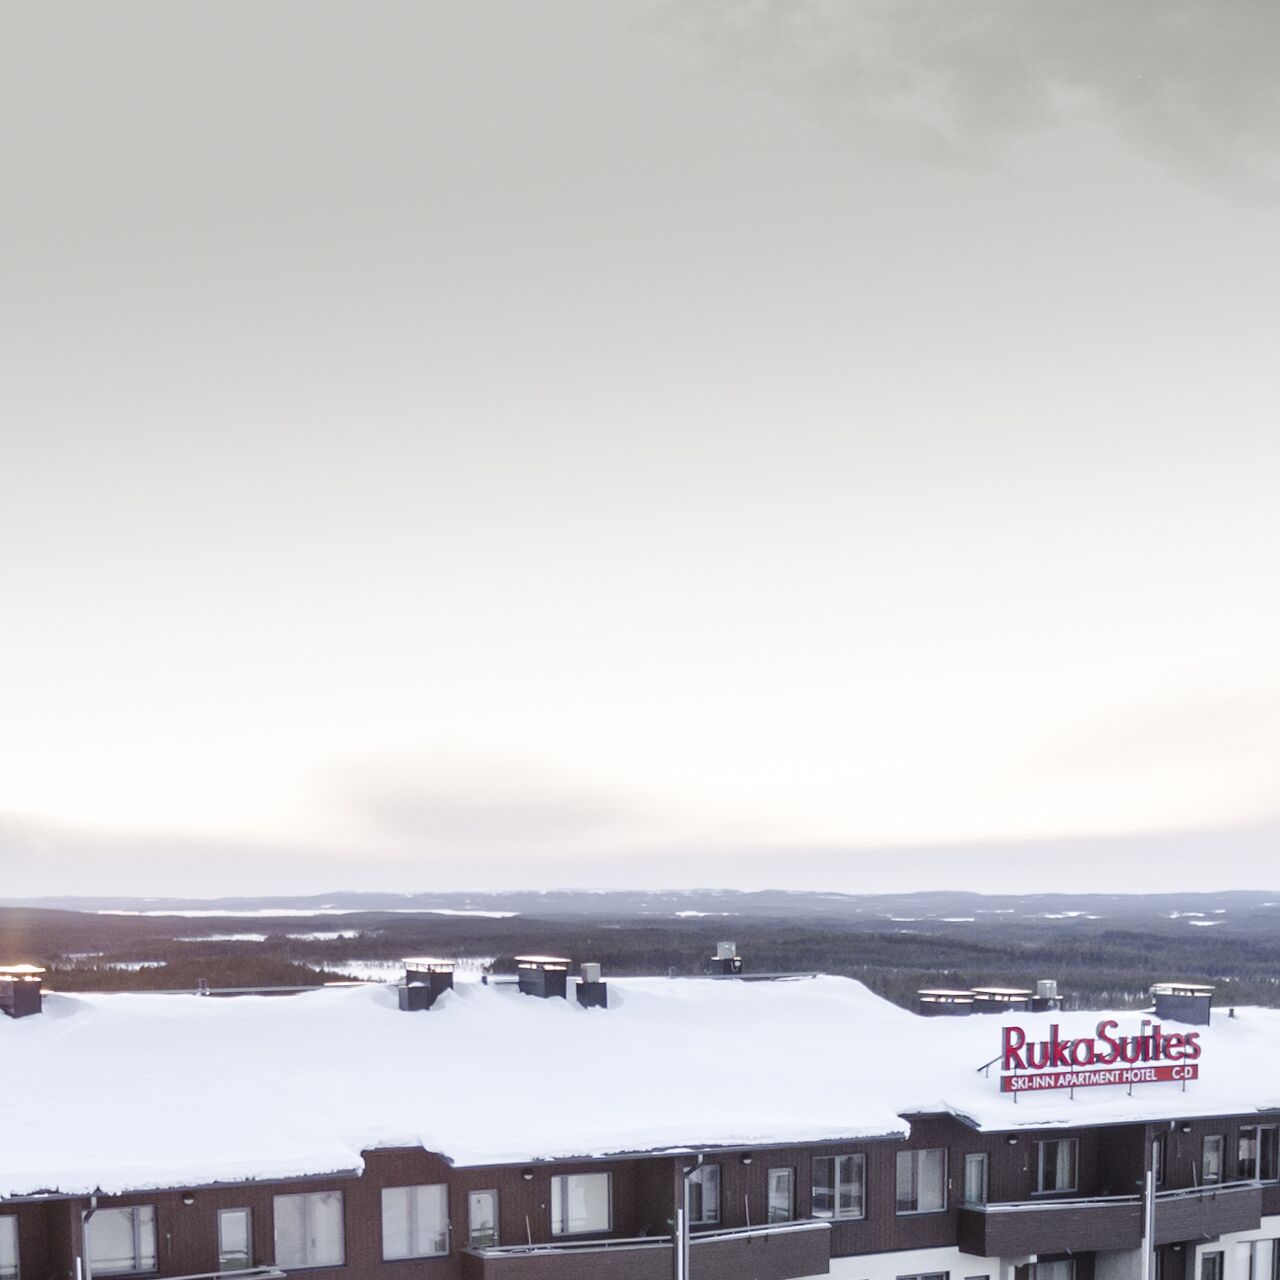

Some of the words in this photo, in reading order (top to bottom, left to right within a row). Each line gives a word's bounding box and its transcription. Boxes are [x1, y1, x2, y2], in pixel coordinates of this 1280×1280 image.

[1001, 1020, 1201, 1071] RukaSuites
[1010, 1075, 1055, 1091] SKI-INN
[1057, 1070, 1122, 1087] APARTMENT
[1122, 1069, 1158, 1082] HOTEL
[1171, 1066, 1194, 1080] C-D
